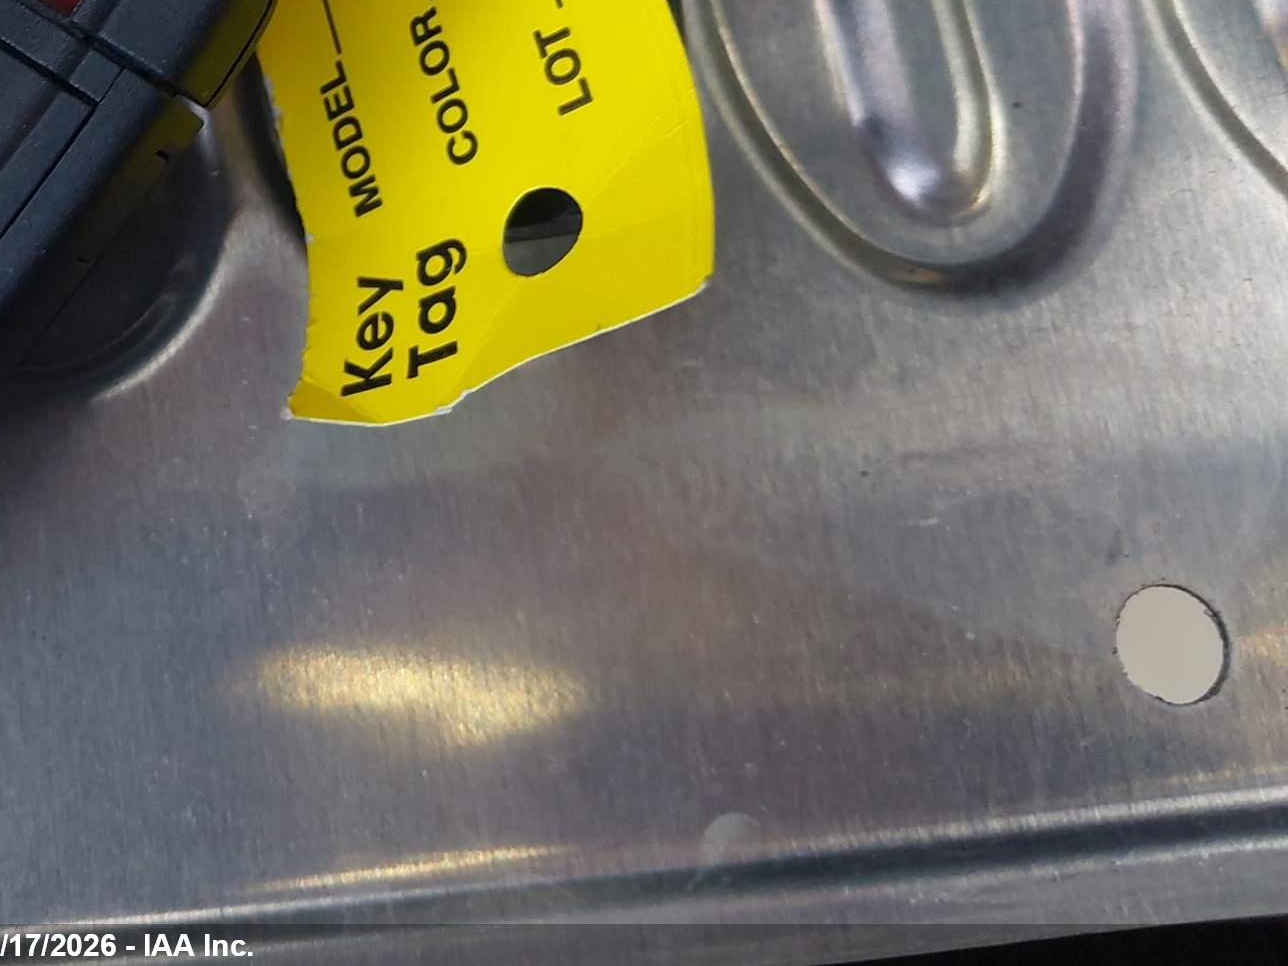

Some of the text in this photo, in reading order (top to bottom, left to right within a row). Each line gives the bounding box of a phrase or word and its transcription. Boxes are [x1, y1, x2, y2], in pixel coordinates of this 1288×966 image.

[320, 60, 384, 218] MODEL
[410, 6, 479, 165] COLOR
[533, 26, 594, 116] LOT
[341, 275, 404, 396] Key
[407, 238, 467, 379] Tag
